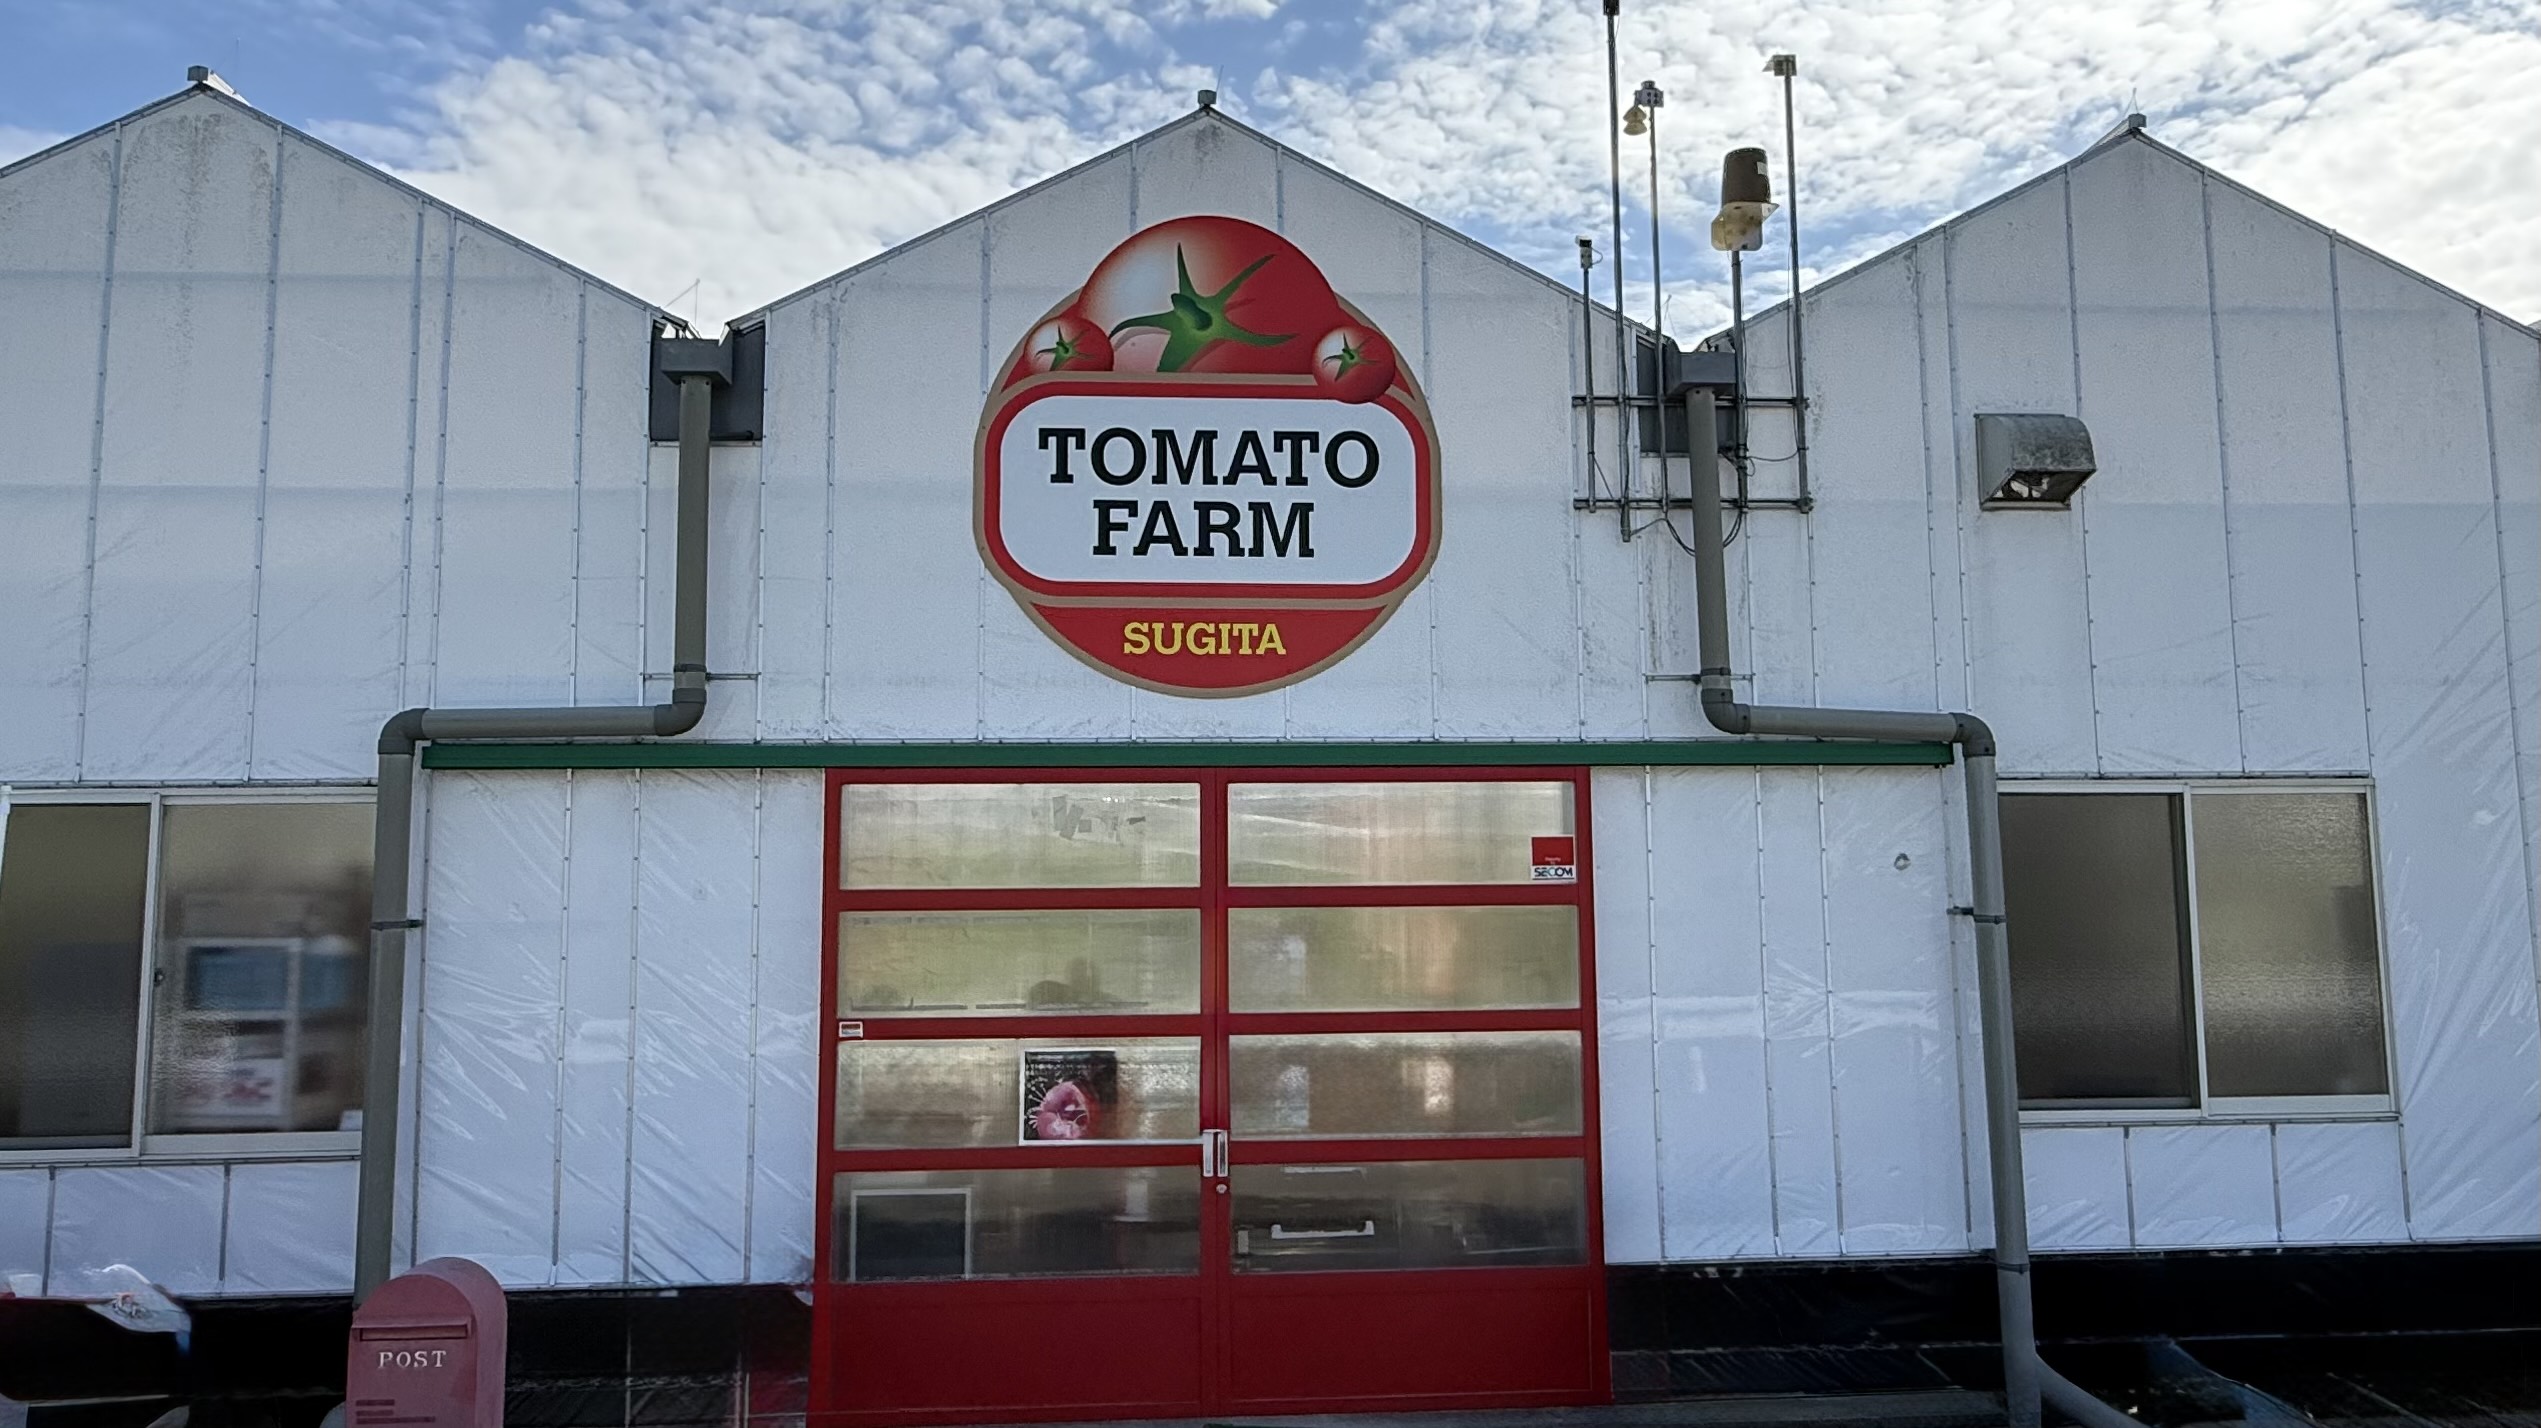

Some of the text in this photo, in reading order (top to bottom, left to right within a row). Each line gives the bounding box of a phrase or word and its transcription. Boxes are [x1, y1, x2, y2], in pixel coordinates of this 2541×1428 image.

[1038, 427, 1380, 488] TOMATO
[1092, 499, 1315, 558] FARM
[1123, 621, 1286, 655] SUGITA
[1534, 867, 1573, 877] SECOM
[378, 1350, 446, 1368] POST
